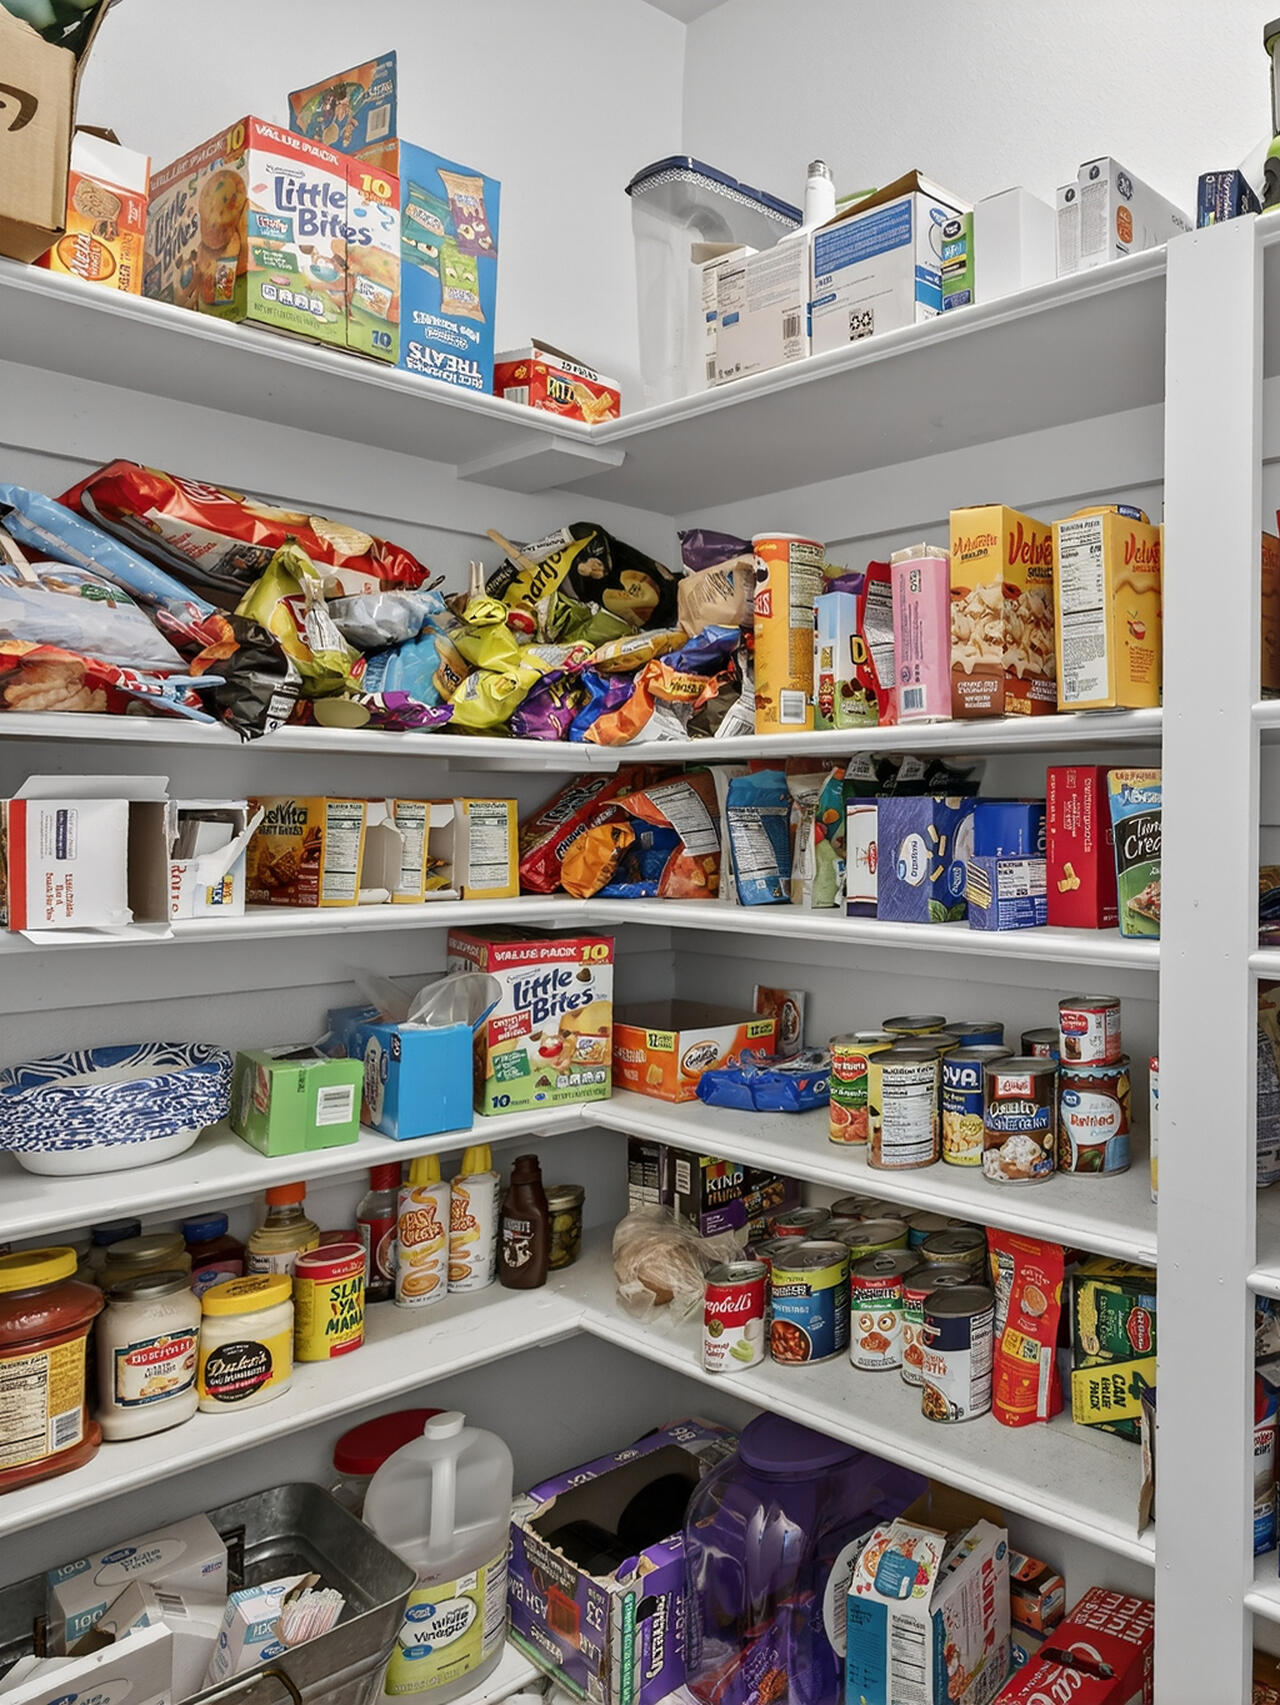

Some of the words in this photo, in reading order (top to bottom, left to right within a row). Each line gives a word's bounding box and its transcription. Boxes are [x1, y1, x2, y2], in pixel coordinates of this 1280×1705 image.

[273, 176, 348, 213] Little
[359, 173, 393, 199] 10
[297, 207, 373, 246] Bites
[494, 948, 538, 961] VALUE
[539, 946, 577, 958] PACK
[580, 944, 610, 961] 10
[512, 968, 573, 1011] Little
[532, 987, 594, 1025] Bites
[491, 1094, 511, 1109] 10
[705, 1171, 745, 1193] KIND
[324, 1313, 363, 1336] MAMA
[338, 1300, 357, 1316] YA
[1111, 1373, 1127, 1408] CAN
[1085, 1592, 1124, 1632] mini
[1103, 1598, 1142, 1638] mini
